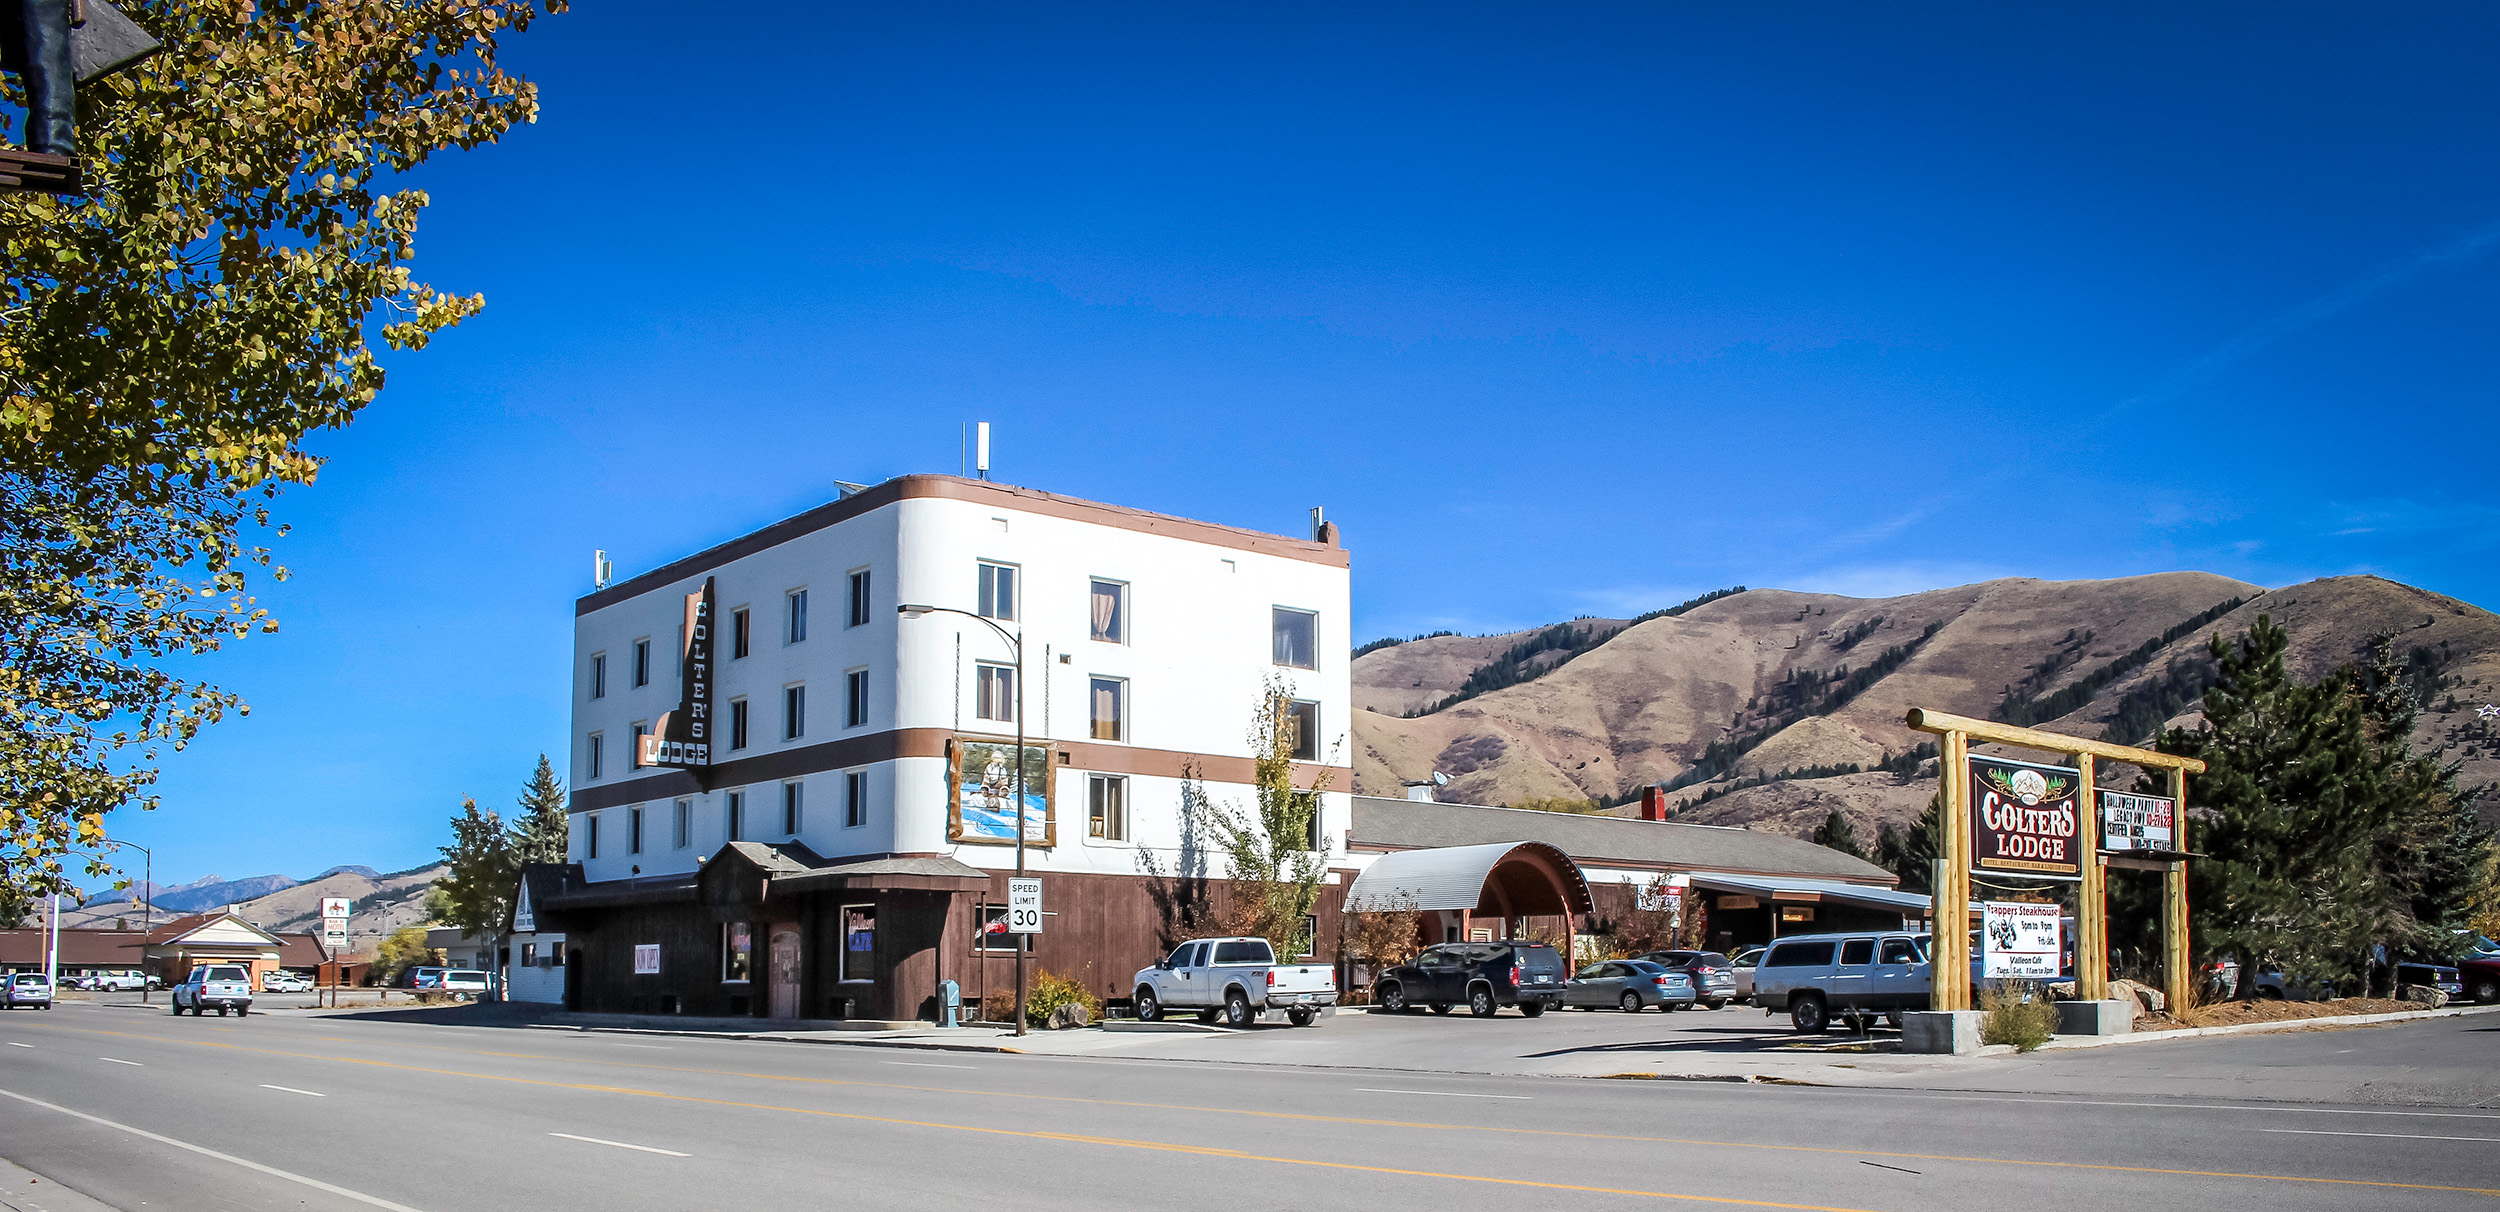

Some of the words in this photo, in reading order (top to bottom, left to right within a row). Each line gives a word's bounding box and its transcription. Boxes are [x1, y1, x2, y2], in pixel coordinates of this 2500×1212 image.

[691, 601, 708, 738] COLTER'S
[645, 739, 708, 766] LODGE
[1982, 791, 2077, 838] COLTER'S
[1996, 833, 2066, 860] LODGE
[1014, 909, 1037, 926] 30
[1986, 904, 2017, 917] Trappers
[2019, 906, 2058, 916] Steakhouse
